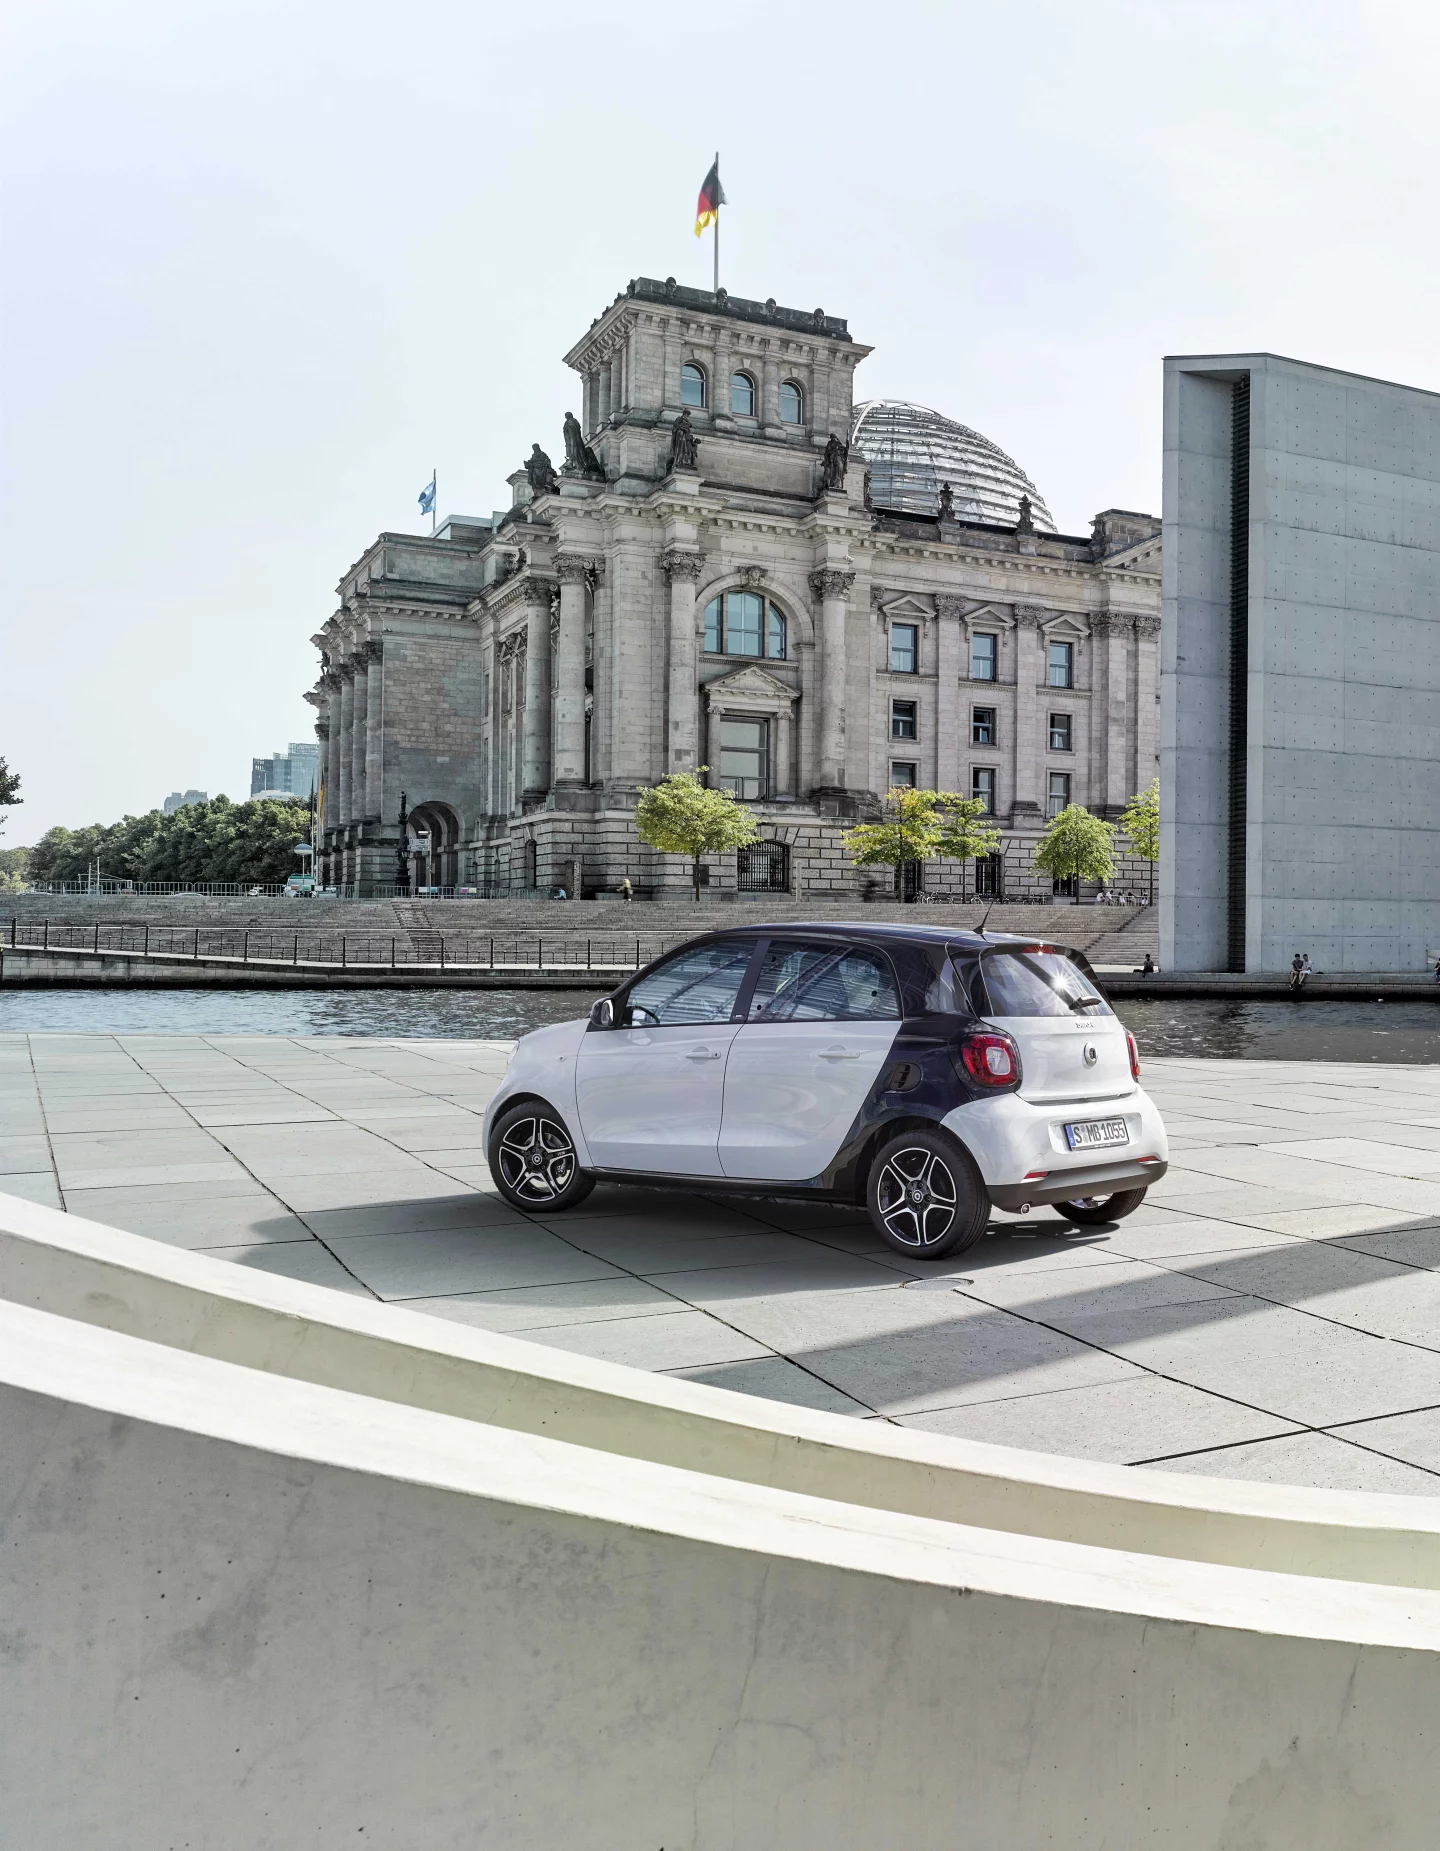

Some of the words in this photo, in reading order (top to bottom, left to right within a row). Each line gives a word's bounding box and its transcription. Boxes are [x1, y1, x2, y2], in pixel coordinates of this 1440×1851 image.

[1073, 1126, 1082, 1143] S
[1086, 1123, 1101, 1142] MB
[1101, 1121, 1125, 1140] 1055
